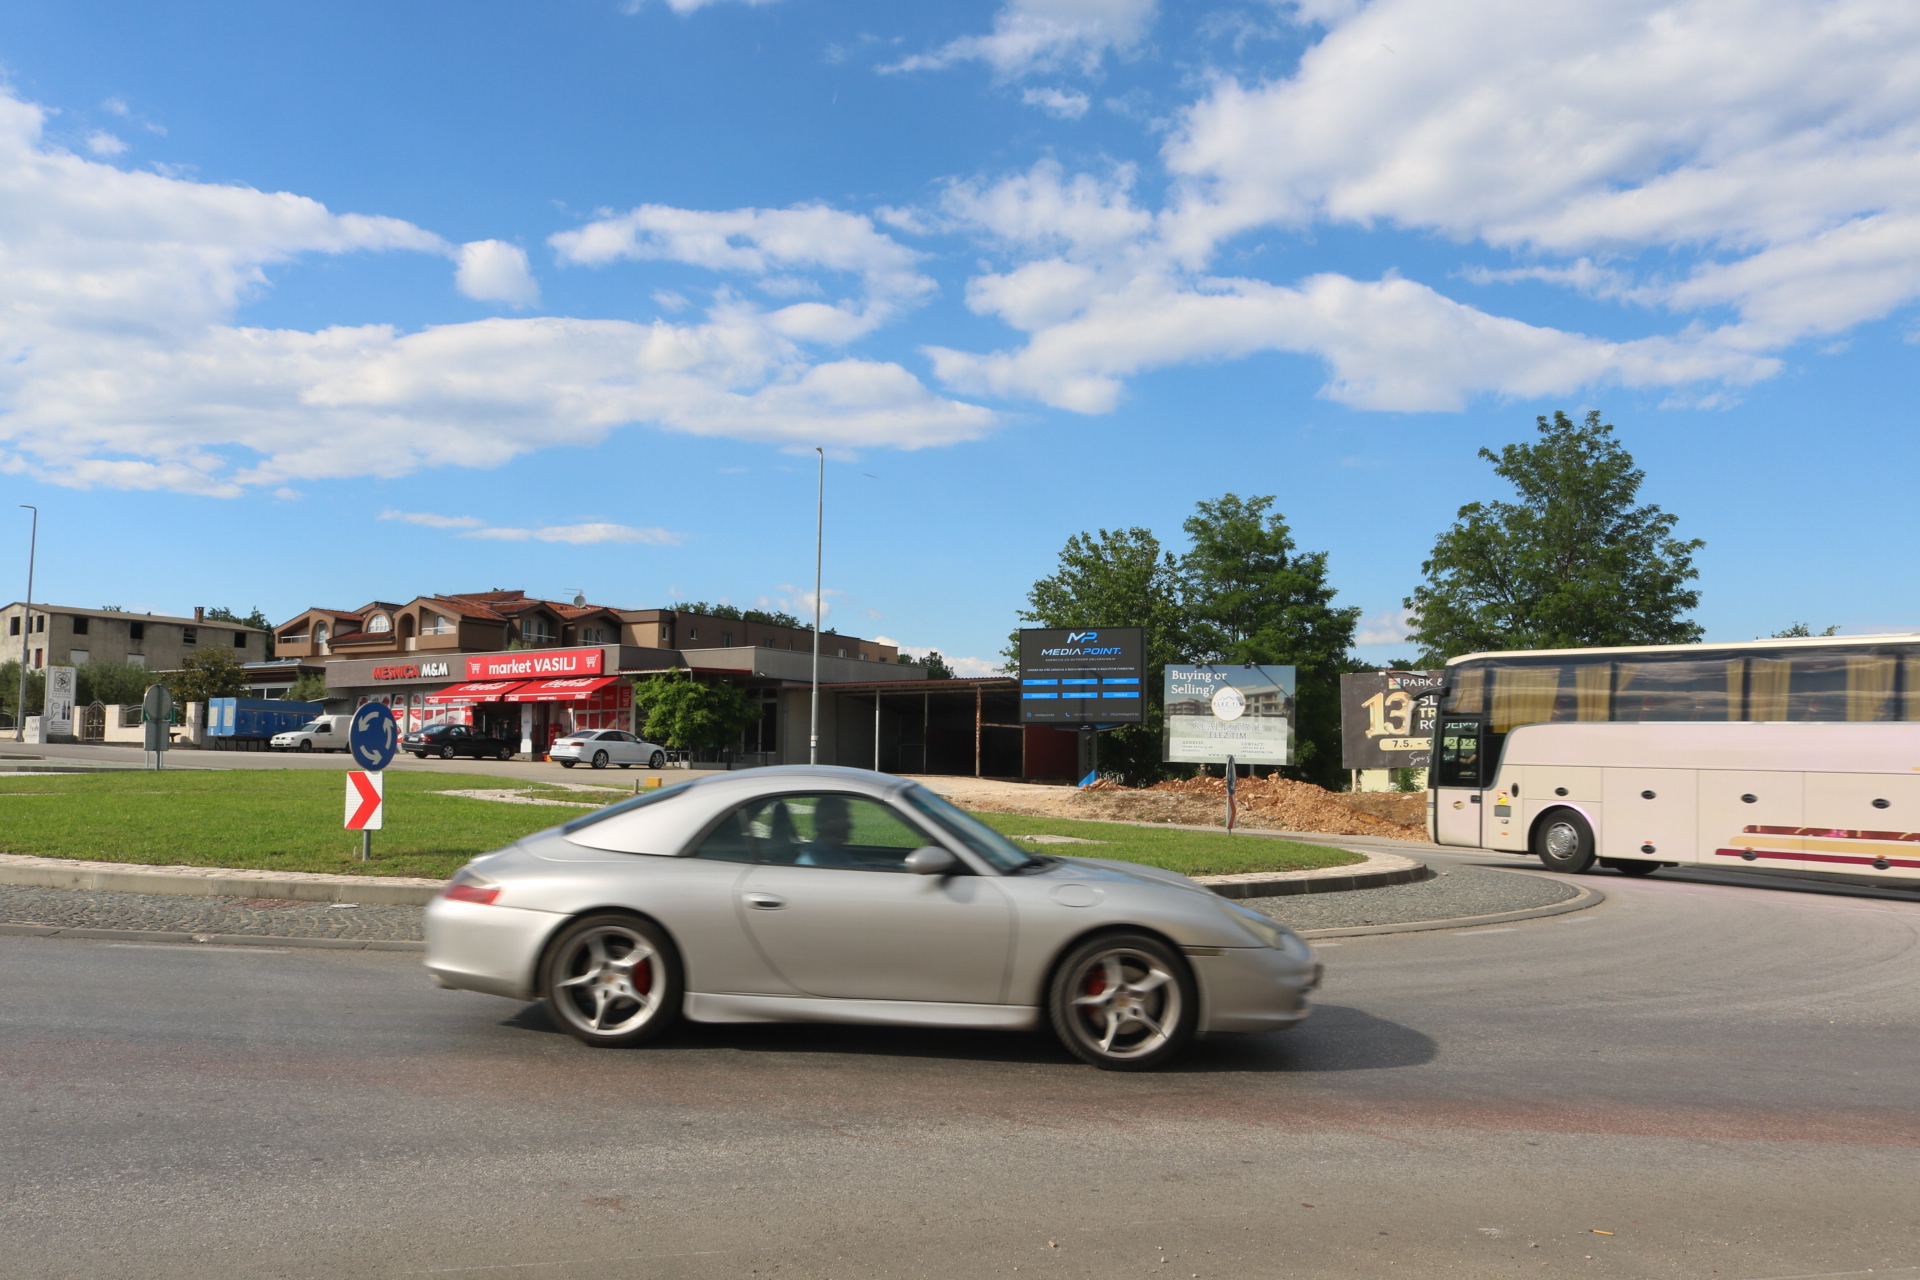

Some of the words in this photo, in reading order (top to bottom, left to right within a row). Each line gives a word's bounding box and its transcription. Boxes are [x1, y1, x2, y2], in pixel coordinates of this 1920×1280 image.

[372, 664, 419, 679] MESNICA
[421, 662, 449, 677] M&M
[488, 659, 531, 675] market
[534, 656, 577, 672] VASILJ
[1171, 670, 1212, 683] Buying
[1214, 672, 1227, 680] or
[1402, 678, 1434, 687] PARK
[1170, 684, 1215, 697] Selling?
[1361, 692, 1411, 738] 13
[1193, 721, 1220, 731] REAL
[1223, 722, 1263, 732] ESTATE
[1392, 740, 1413, 748] 7.5.
